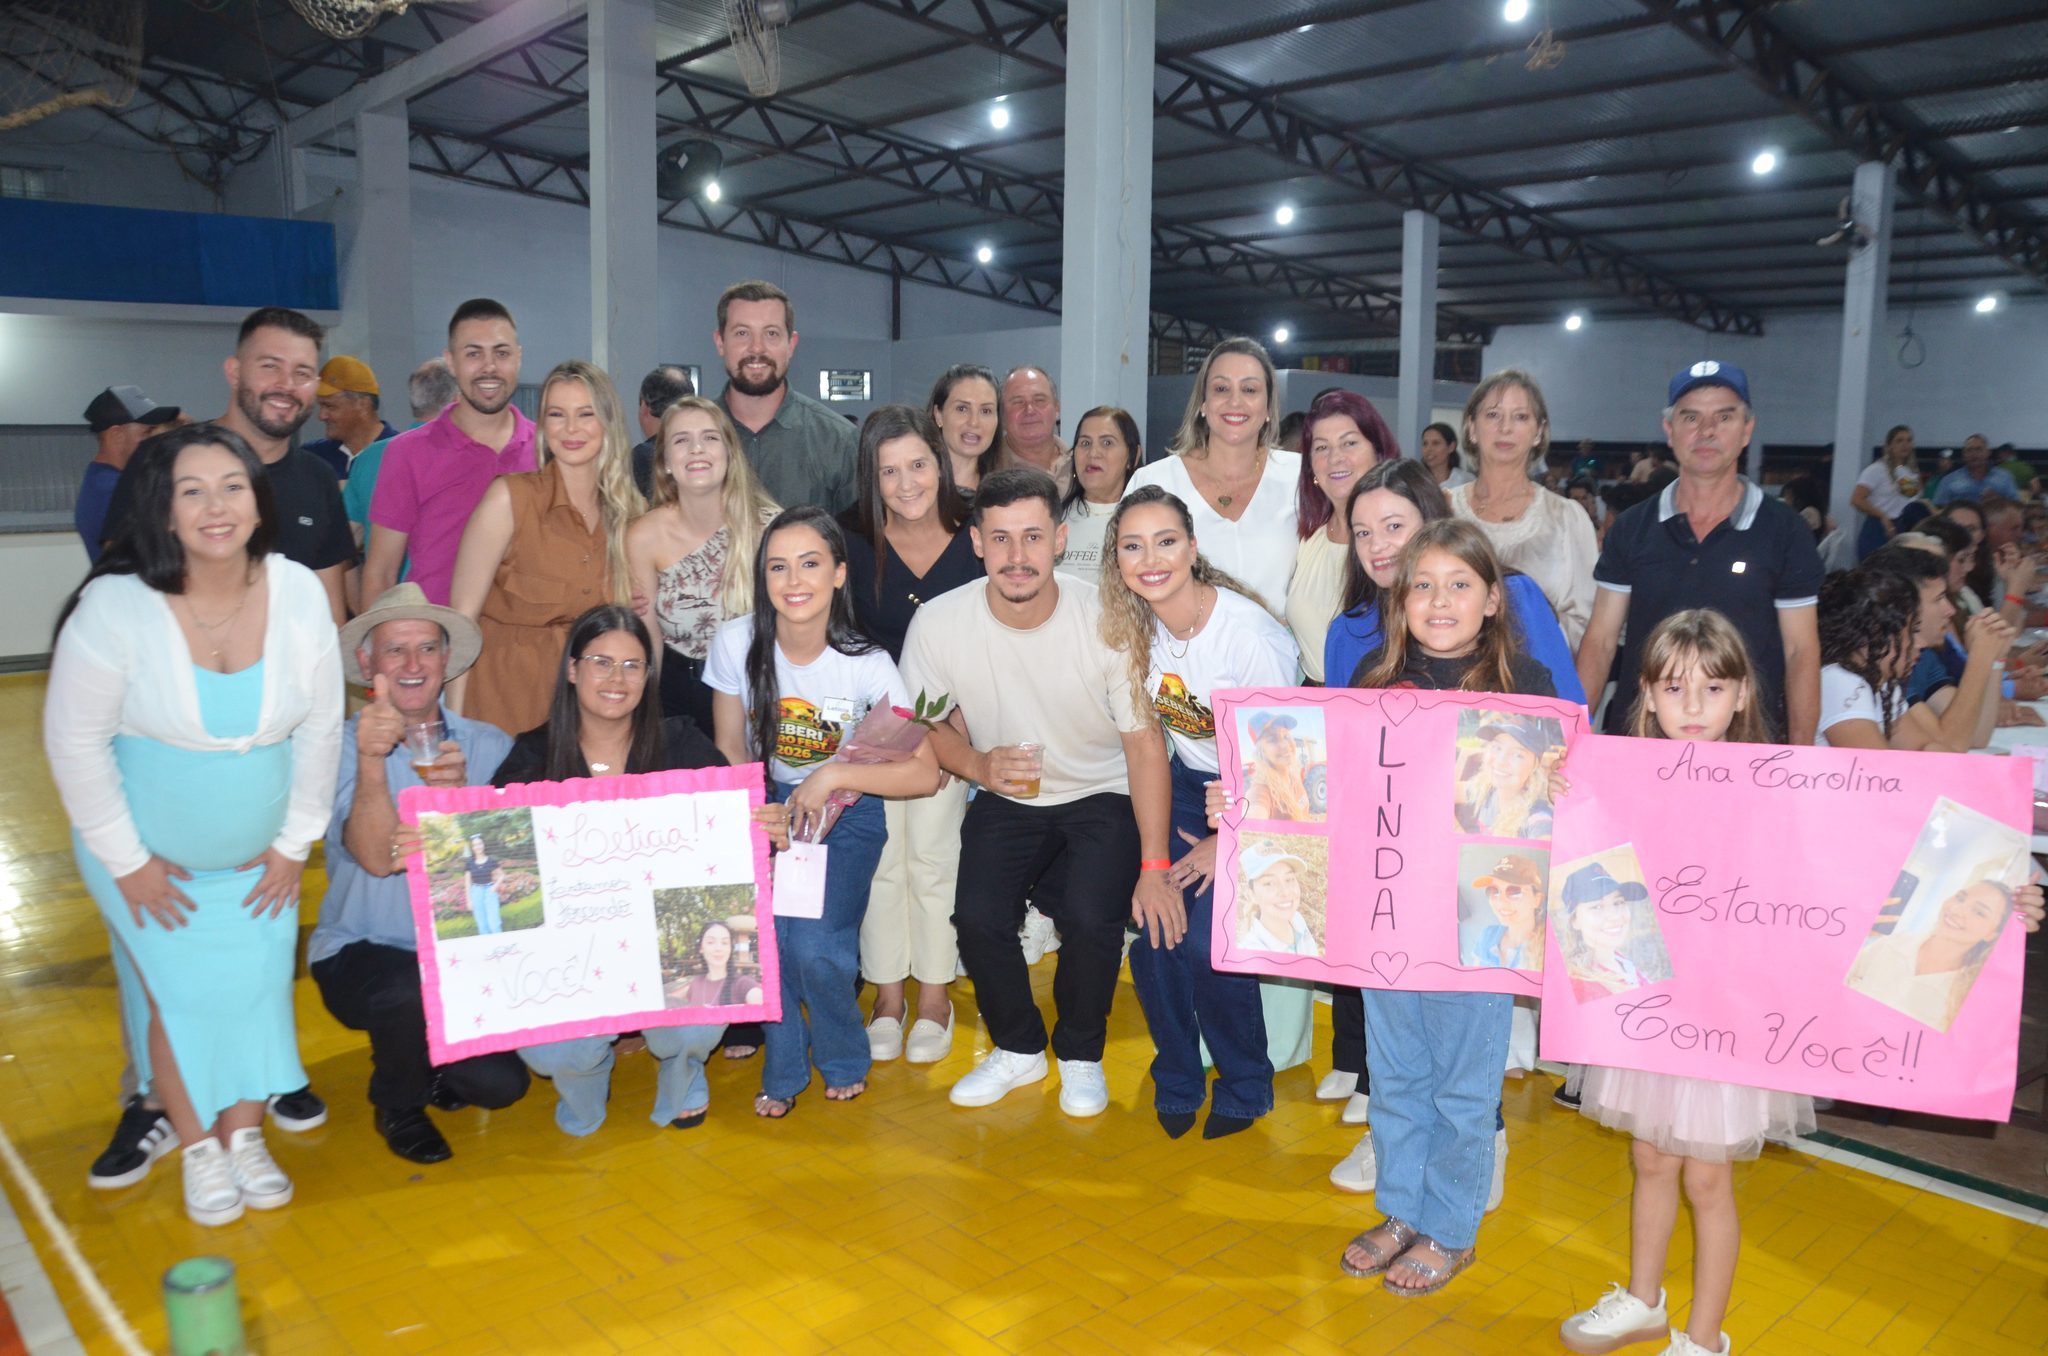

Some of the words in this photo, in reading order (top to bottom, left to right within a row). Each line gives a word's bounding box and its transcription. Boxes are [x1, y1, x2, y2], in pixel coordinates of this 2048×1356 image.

[1063, 550, 1098, 561] OFFEE
[1156, 694, 1200, 722] SEBERI
[780, 723, 823, 742] EBERI
[797, 737, 828, 751] FEST
[776, 744, 812, 759] 2026
[1657, 742, 1734, 783] Ana
[1749, 750, 1903, 793] Carolina
[1371, 726, 1406, 931] LINDA
[1656, 865, 1847, 937] Estamos
[1615, 994, 1736, 1057] Com
[1764, 1012, 1923, 1084] Você!!
